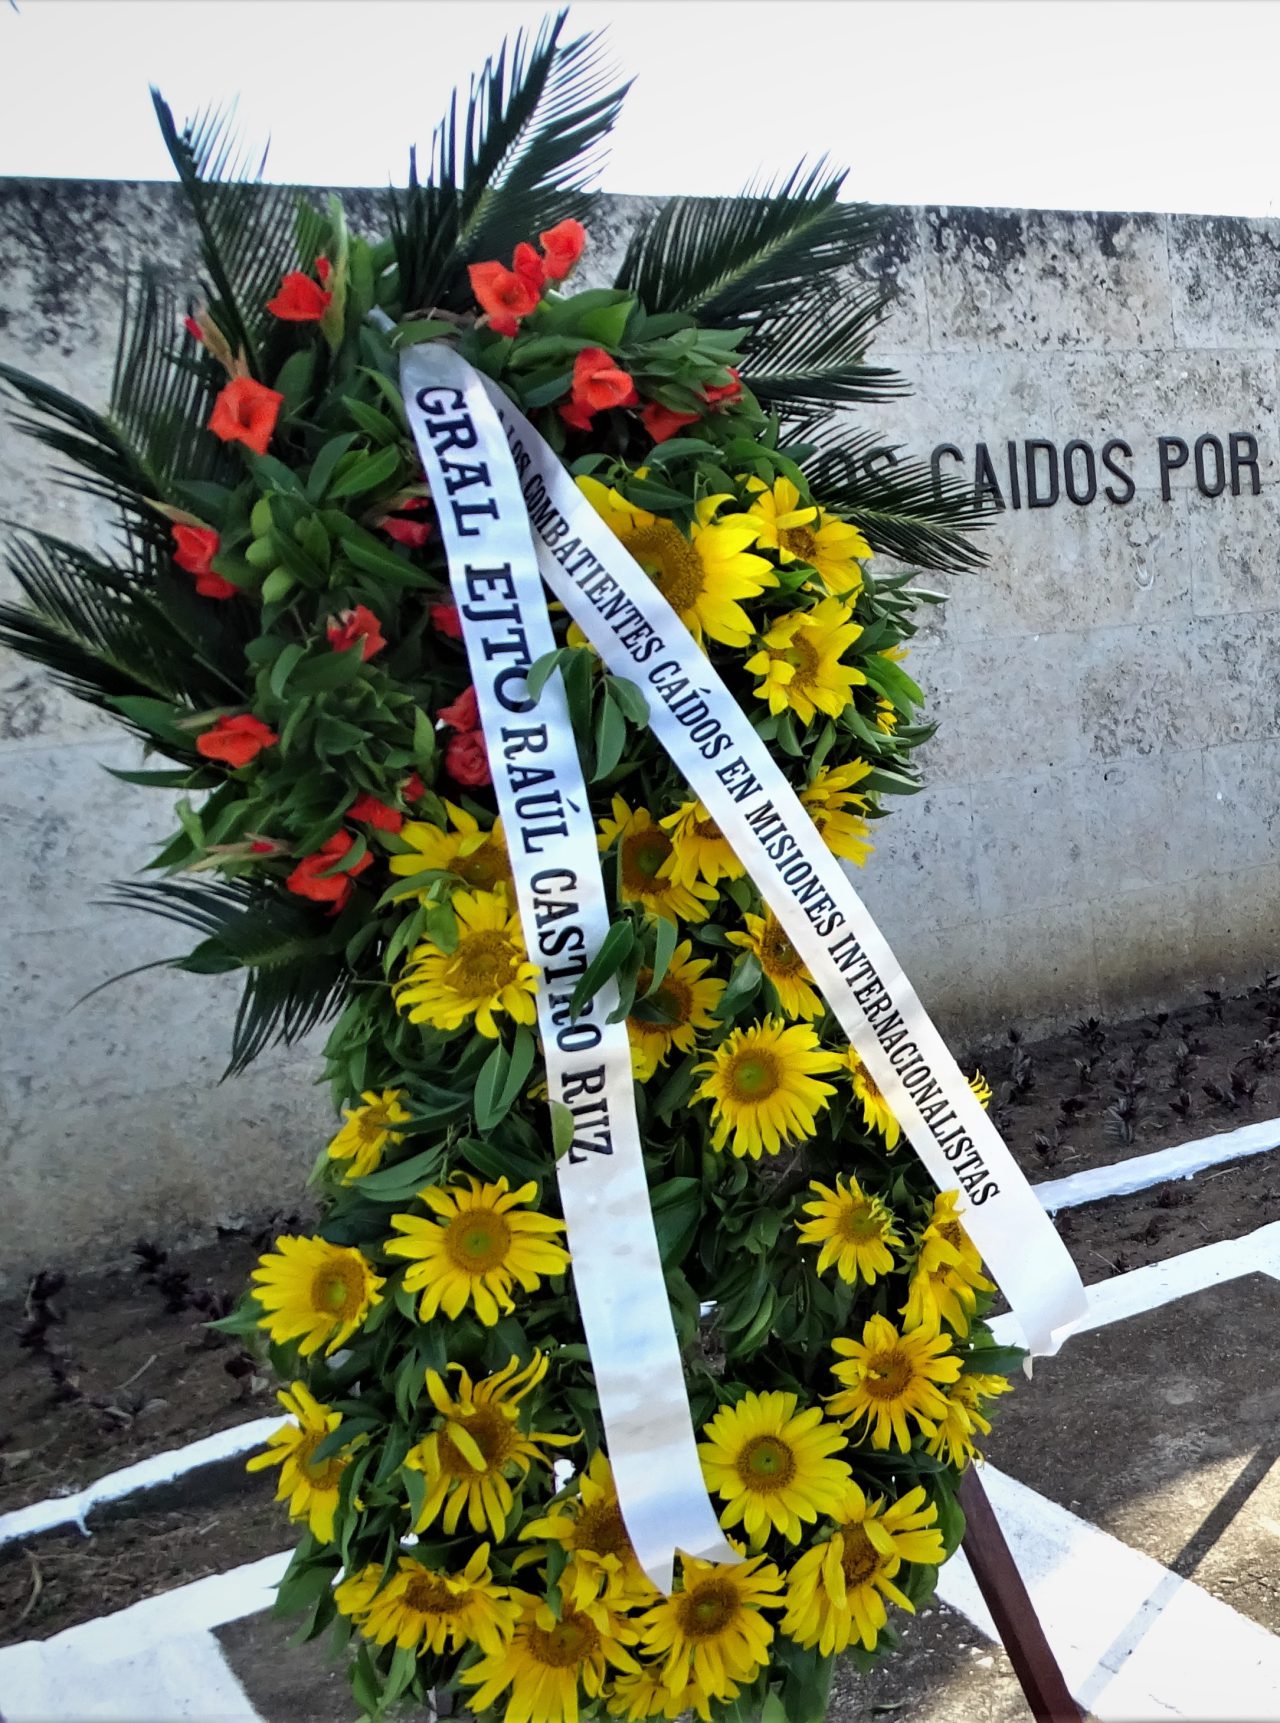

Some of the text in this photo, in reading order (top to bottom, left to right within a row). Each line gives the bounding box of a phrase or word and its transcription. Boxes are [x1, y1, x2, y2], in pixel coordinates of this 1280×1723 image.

[416, 386, 614, 1165] GRAL EJTO RAÚL CASTRO RUZ
[931, 437, 1136, 509] CAIDOS
[1159, 432, 1260, 500] POR
[523, 473, 666, 663] COMBATIENTES
[648, 660, 734, 759] CAÍDOS
[715, 755, 764, 804] EN
[744, 799, 847, 938] MISIONES
[828, 931, 1000, 1206] INTERNACIONALISTAS
